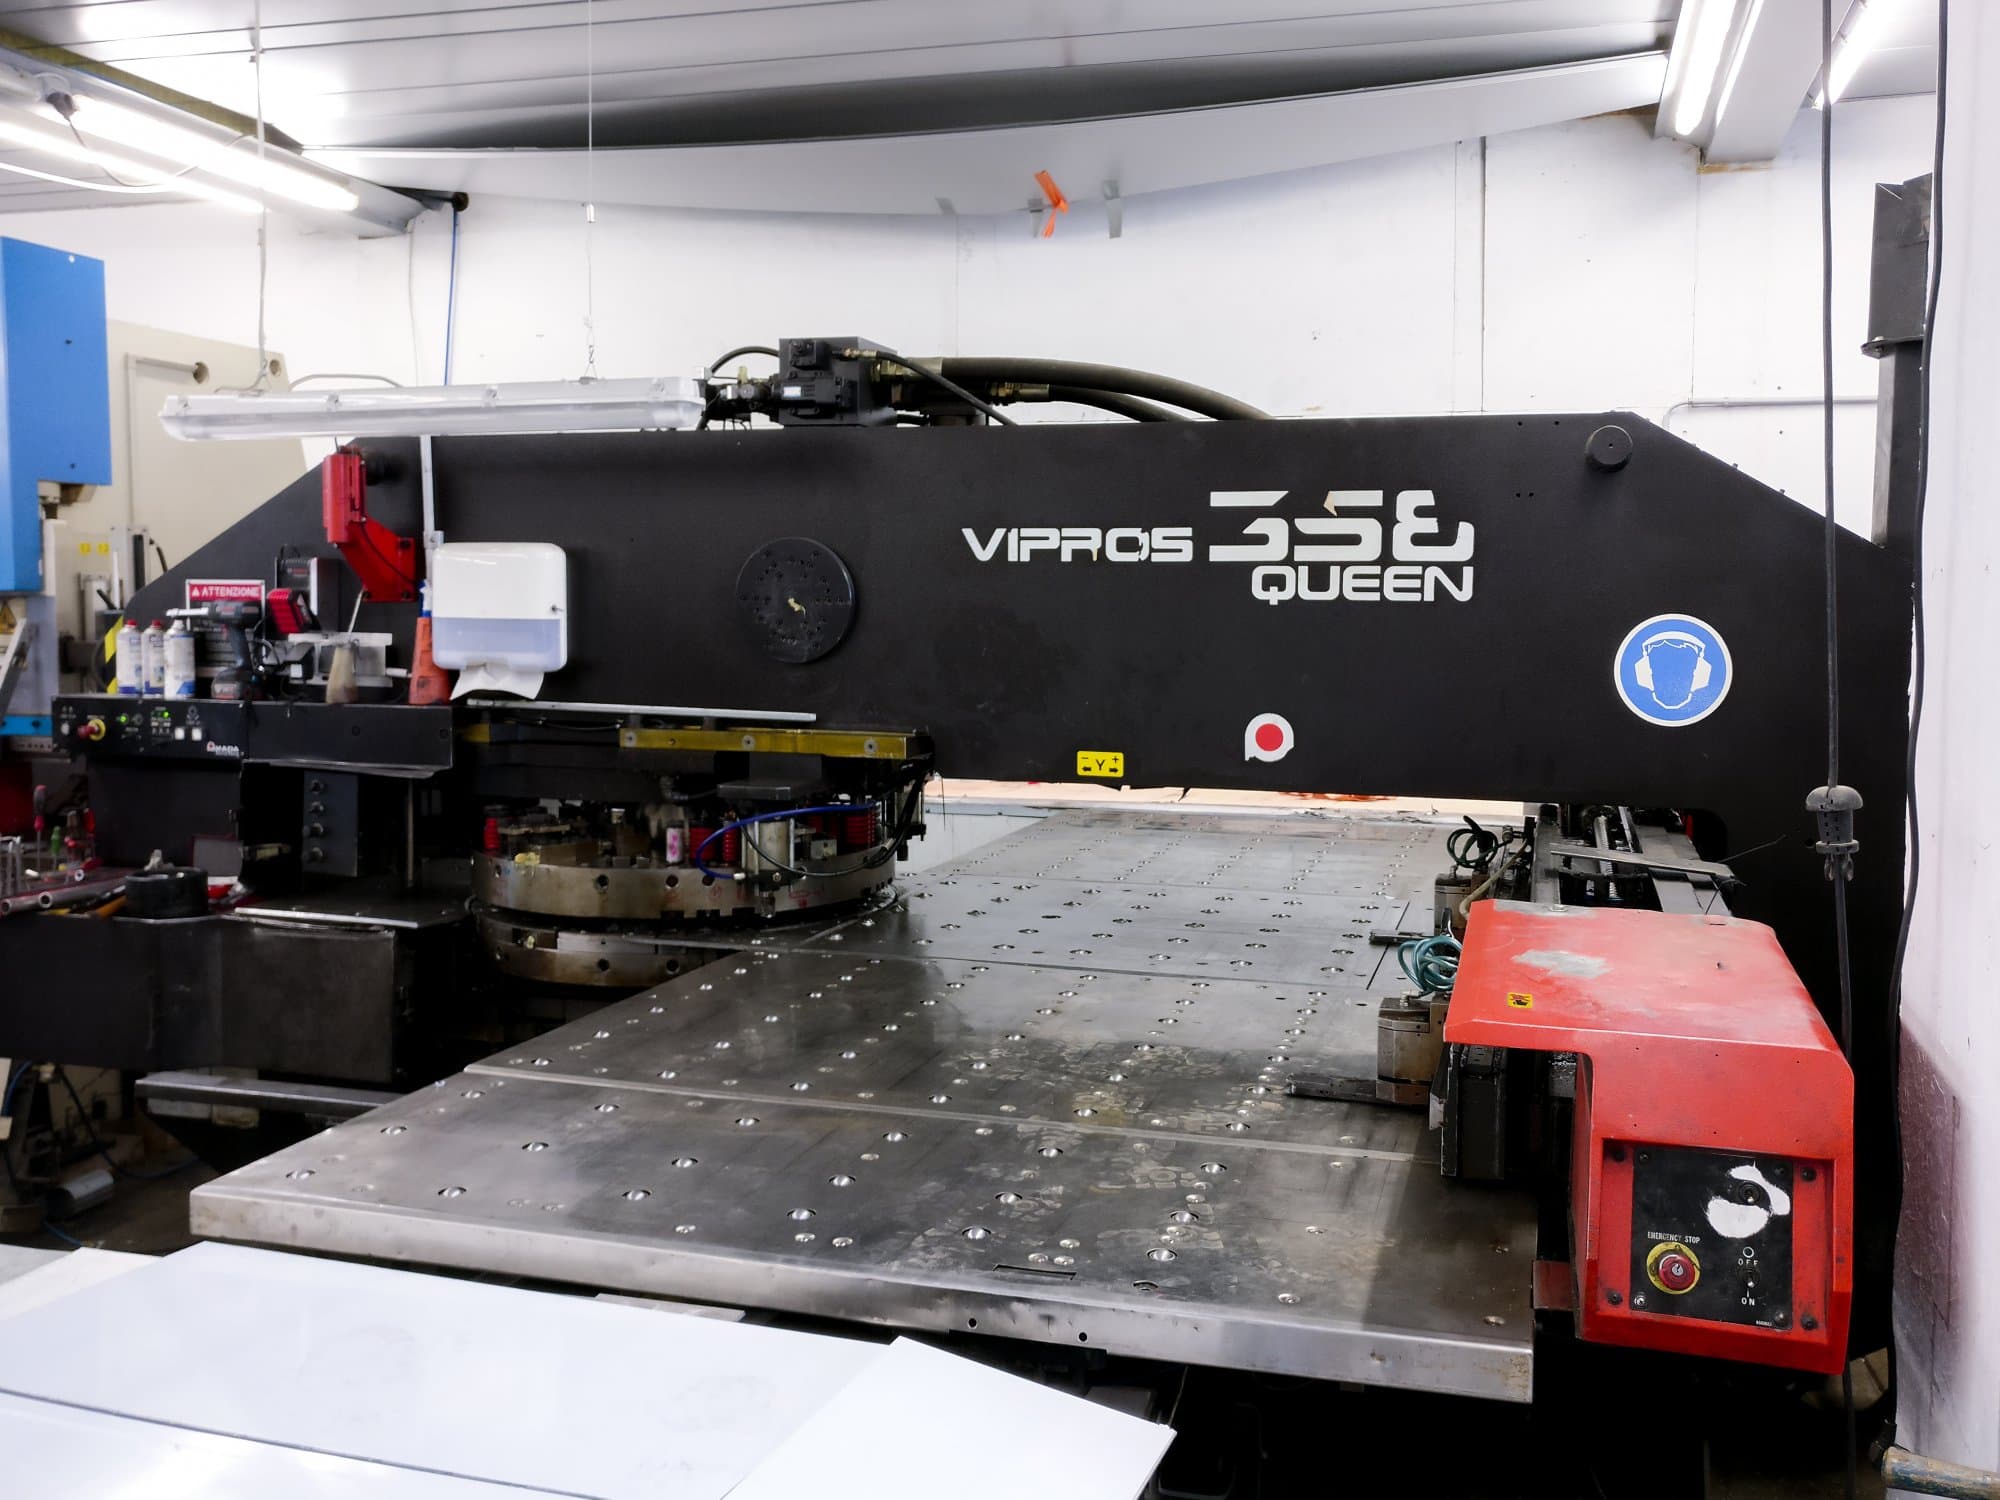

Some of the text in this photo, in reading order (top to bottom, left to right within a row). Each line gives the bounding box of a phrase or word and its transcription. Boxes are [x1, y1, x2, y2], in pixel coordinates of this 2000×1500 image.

[961, 527, 1194, 563] VIPROS
[201, 585, 260, 598] ATTENZIONE
[1251, 565, 1474, 605] QUEEN
[1647, 1231, 1701, 1244] EMERGENCY STOP
[1737, 1258, 1759, 1266] OFF
[1741, 1297, 1755, 1306] ON
